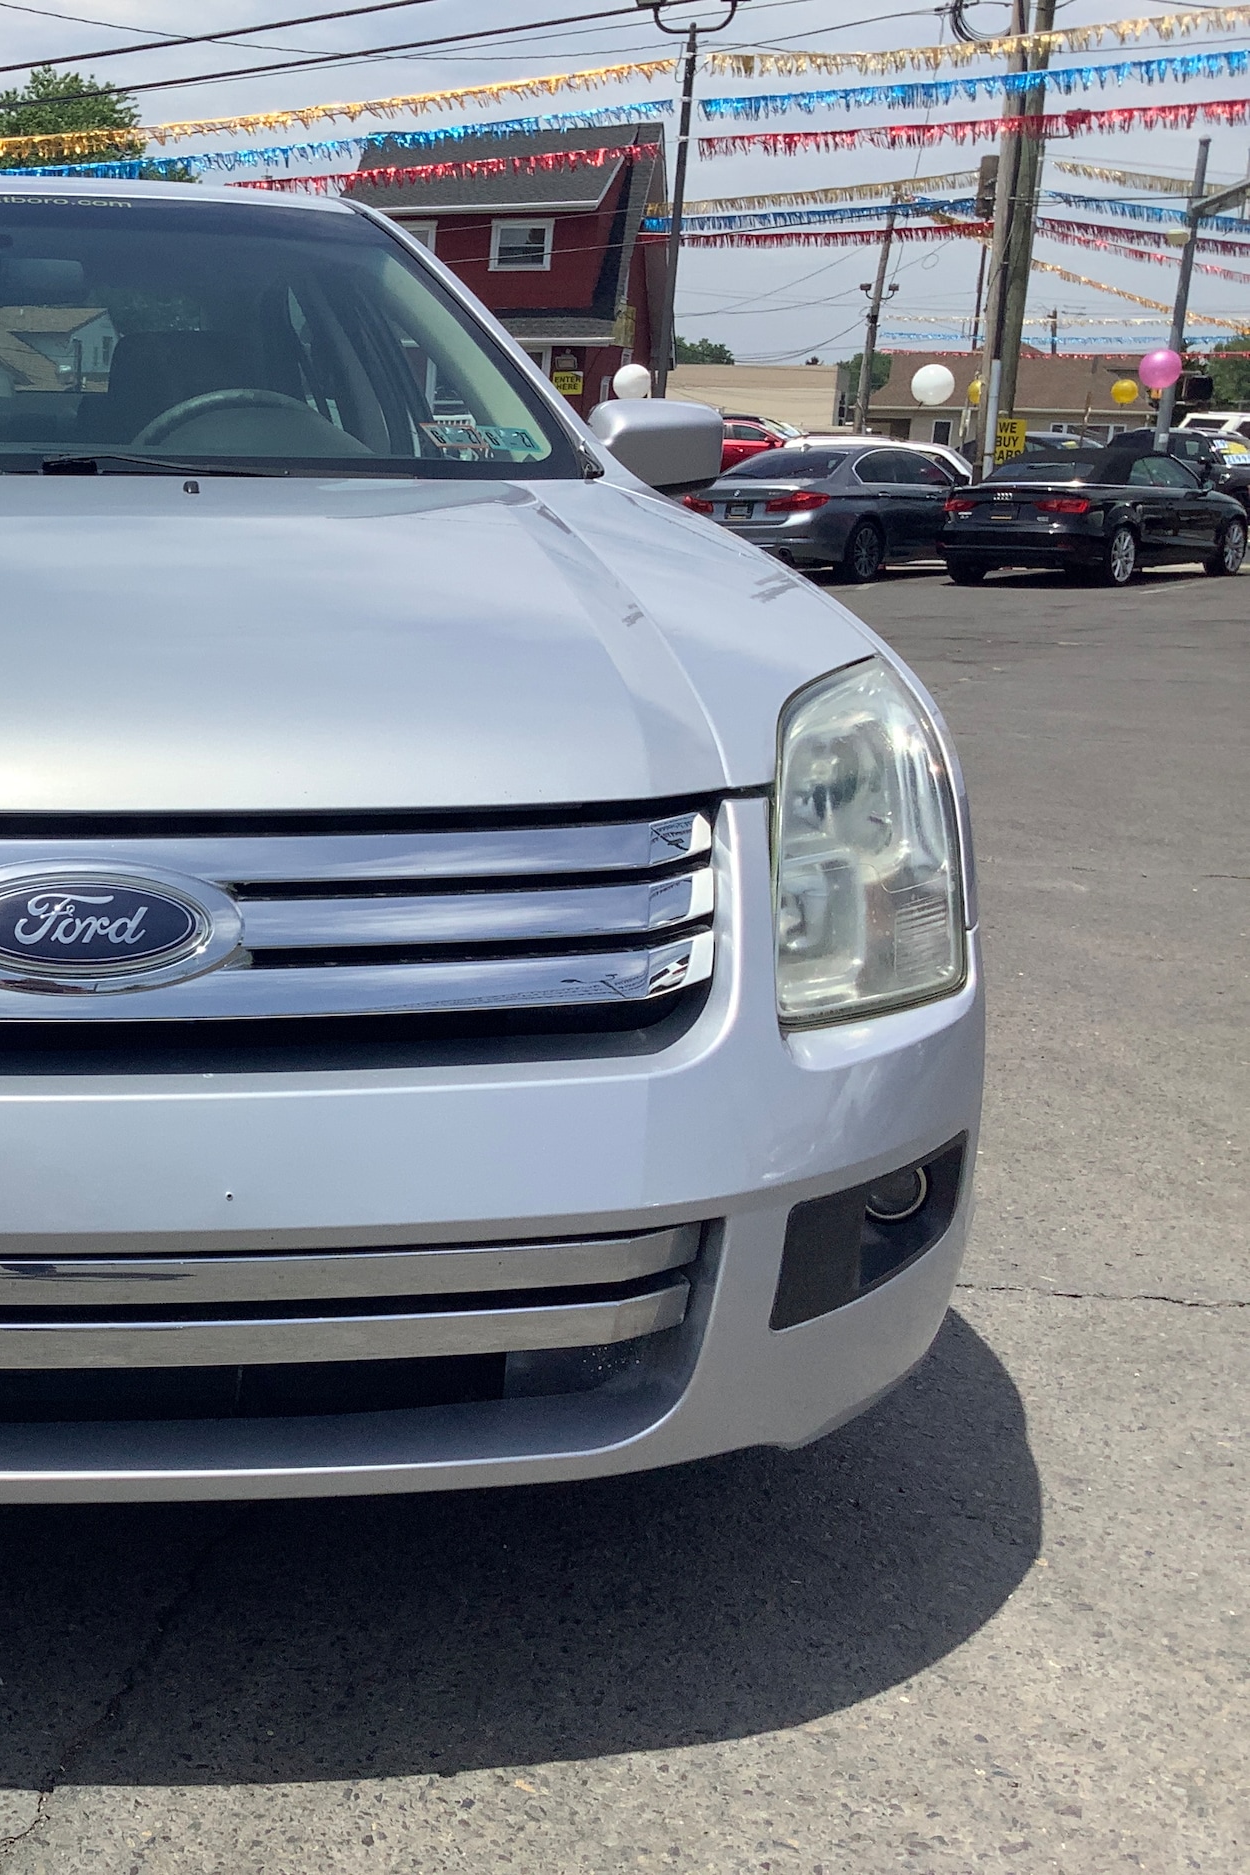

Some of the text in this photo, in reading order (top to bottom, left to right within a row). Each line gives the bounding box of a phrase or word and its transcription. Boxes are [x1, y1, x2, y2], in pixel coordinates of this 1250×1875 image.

[554, 375, 582, 383] ENTER
[999, 422, 1017, 433] WE
[996, 436, 1019, 448] BUY
[994, 450, 1021, 461] AR
[14, 892, 149, 945] Ford
